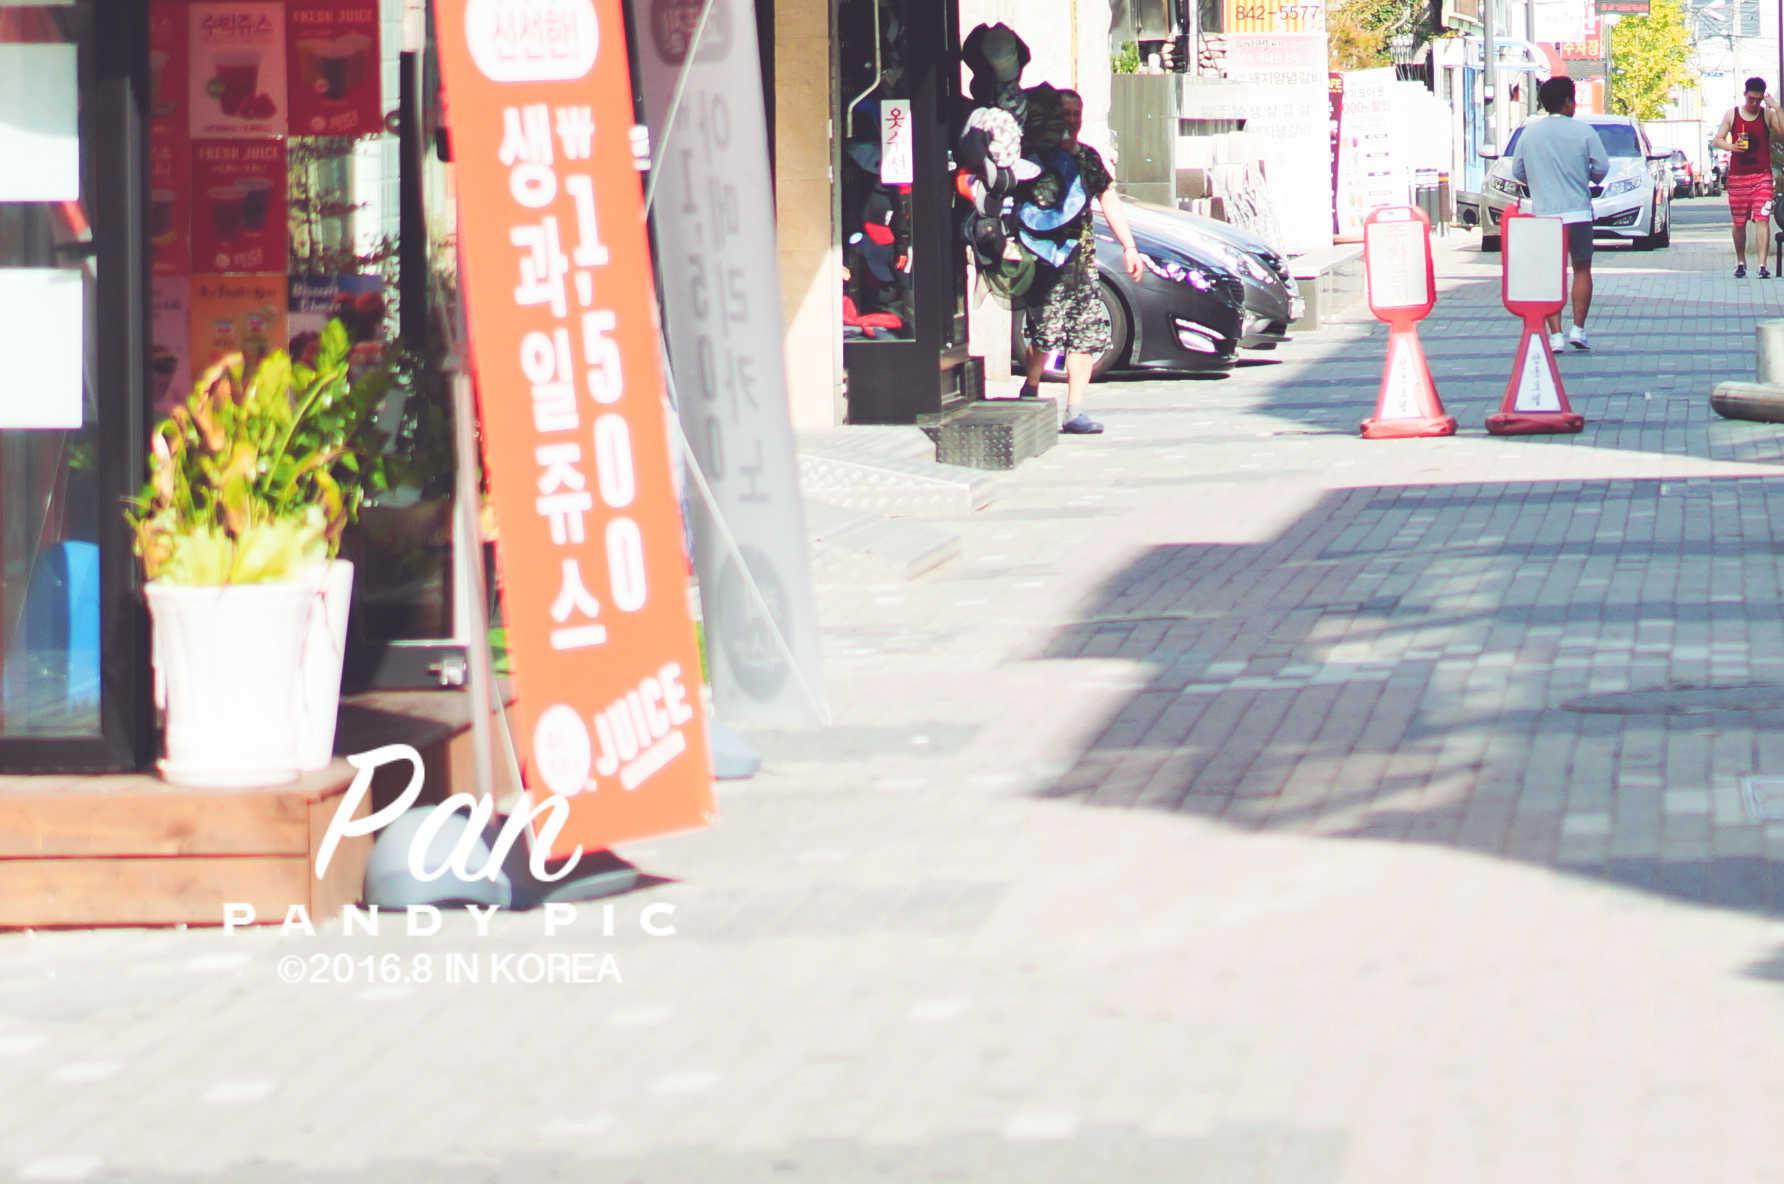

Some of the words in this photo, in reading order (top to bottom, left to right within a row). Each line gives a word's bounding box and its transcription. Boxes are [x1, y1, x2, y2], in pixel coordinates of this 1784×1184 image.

[1235, 5, 1319, 21] 842-5577
[496, 103, 608, 651] 생과일쥬스
[595, 661, 693, 775] JUICE
